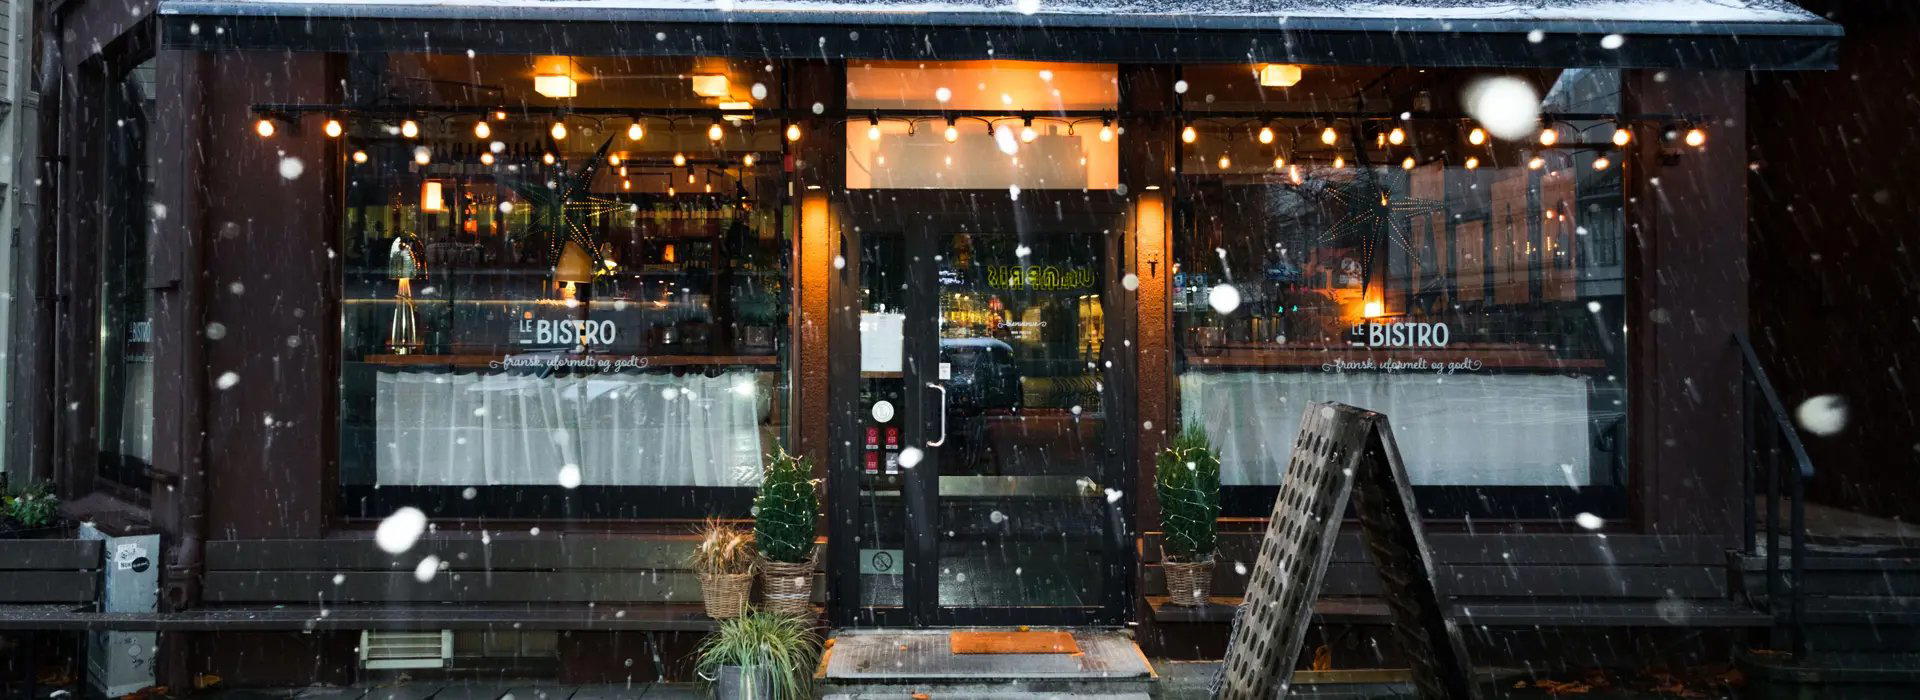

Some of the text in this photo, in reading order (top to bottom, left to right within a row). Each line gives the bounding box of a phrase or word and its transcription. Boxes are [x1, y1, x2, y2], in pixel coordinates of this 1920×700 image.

[519, 319, 616, 345] LE BISTRO
[1352, 322, 1450, 347] LE BISTRO
[501, 354, 645, 372] fransk, uformelt og godt
[1334, 357, 1478, 376] fransk, uformelt og godt
